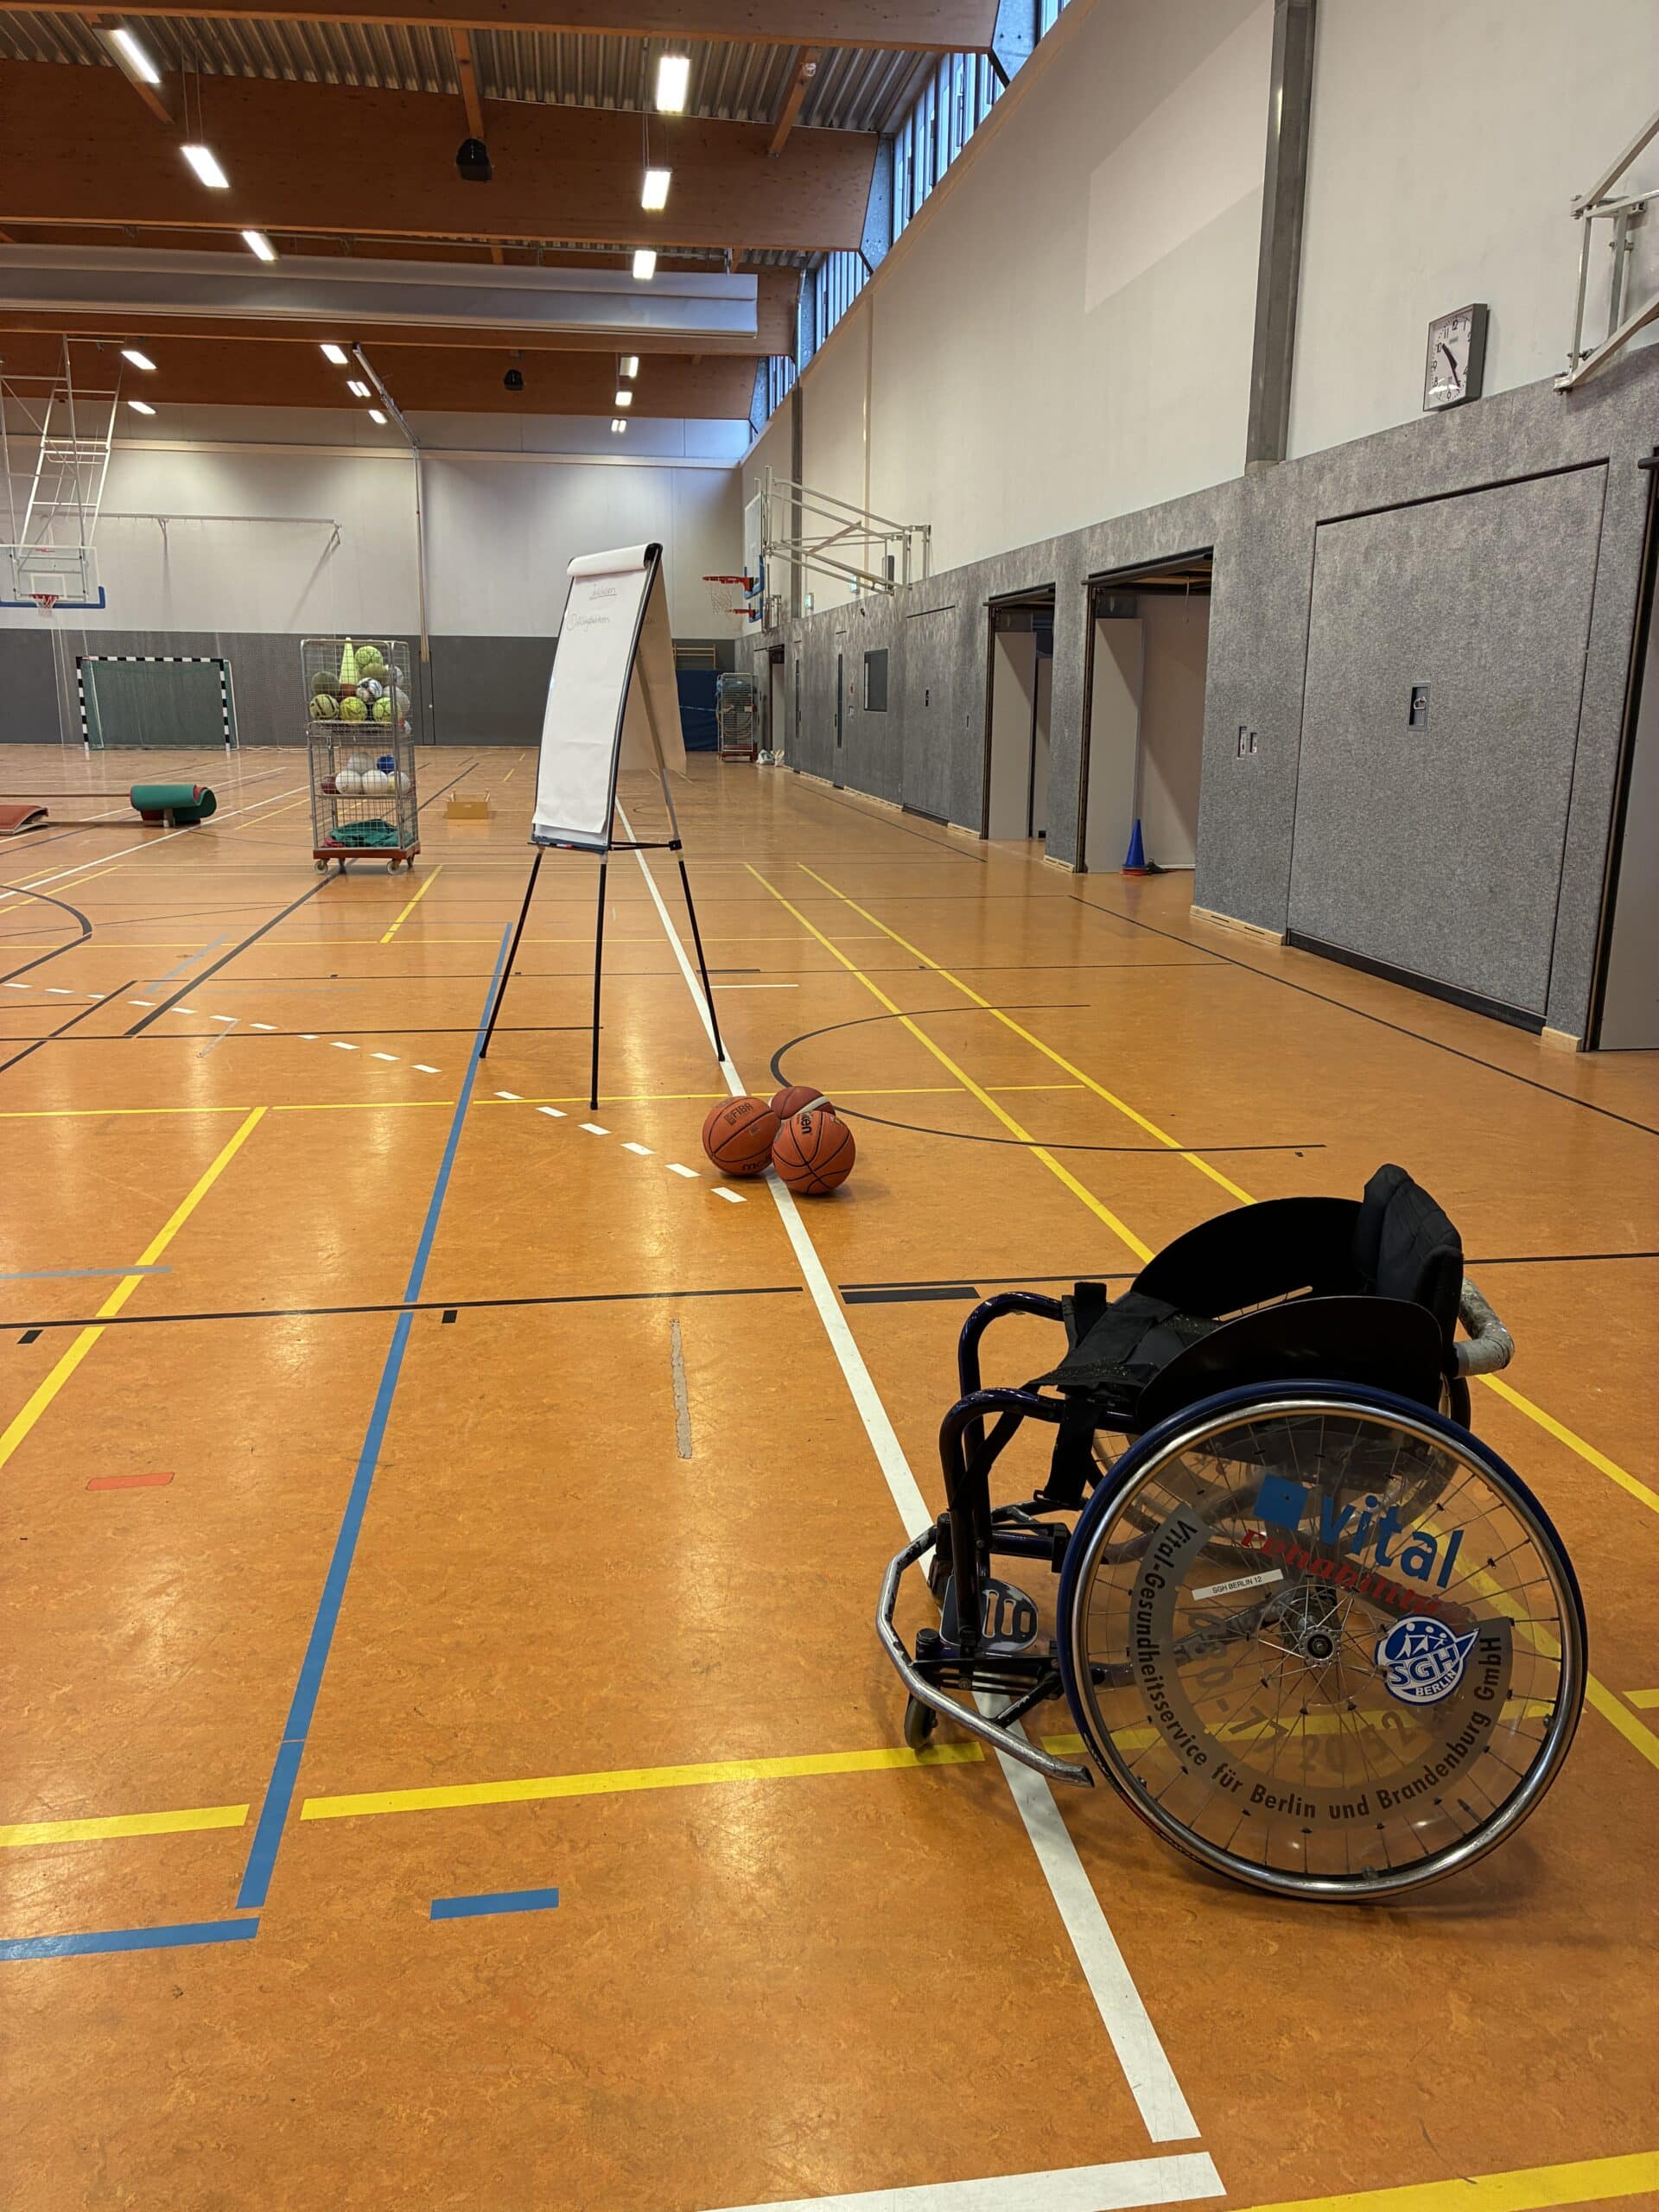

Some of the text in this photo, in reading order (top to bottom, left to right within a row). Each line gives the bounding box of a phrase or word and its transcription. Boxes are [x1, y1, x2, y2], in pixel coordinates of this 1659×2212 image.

[731, 1102, 754, 1121] FIBA
[1319, 1495, 1465, 1589] vital
[1228, 1580, 1253, 1590] BERLIN
[1136, 1521, 1207, 1766] Vital-Gesundheitsservice
[1211, 1763, 1243, 1793] für
[1249, 1783, 1316, 1818] Berlin
[1329, 1794, 1370, 1819] und
[1376, 1711, 1491, 1809] Brandenburg
[1474, 1637, 1502, 1701] GmbH
[1387, 1643, 1459, 1687] SGH
[1415, 1669, 1458, 1696] BERLIN
